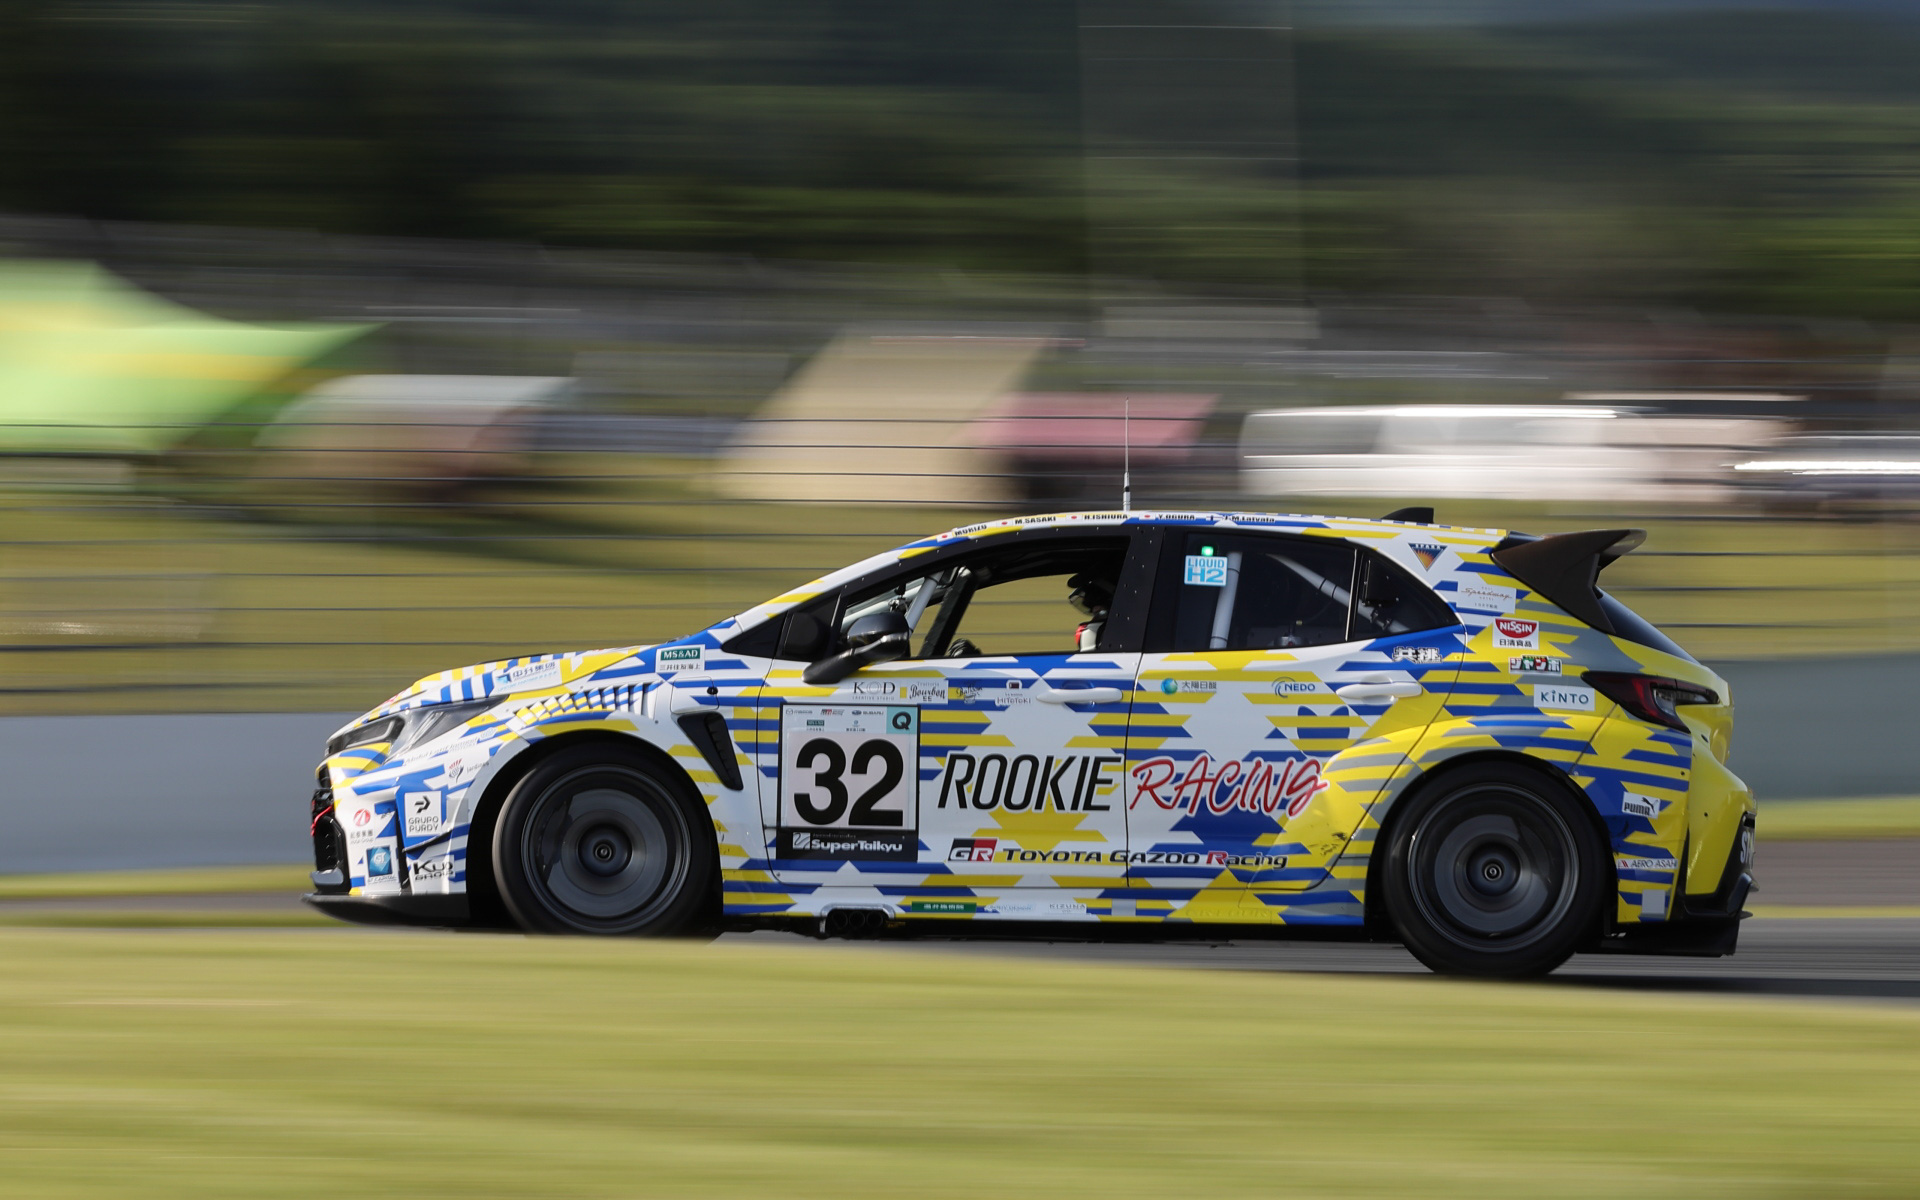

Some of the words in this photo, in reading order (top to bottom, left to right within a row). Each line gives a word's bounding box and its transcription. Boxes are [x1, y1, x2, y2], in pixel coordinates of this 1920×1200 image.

[1015, 516, 1056, 524] M.SASAKI
[1188, 558, 1225, 568] LIQUID
[1187, 568, 1224, 583] H2
[1500, 619, 1533, 634] NISSIN
[1499, 638, 1533, 648] 日清食品
[663, 649, 698, 659] MS&AD
[1510, 657, 1560, 672] ジャンボ
[909, 683, 945, 699] Bourbon
[1284, 682, 1316, 692] NEDO
[892, 711, 912, 730] Q
[793, 737, 904, 827] 32
[938, 754, 1124, 812] ROOKIE
[1129, 756, 1327, 816] RACING
[1623, 801, 1650, 817] PUMA
[408, 815, 439, 824] GRUPO
[409, 824, 439, 833] PURDY
[950, 845, 994, 862] GR
[1002, 847, 1101, 862] TOYOTA
[1109, 849, 1200, 864] GAZOO
[1205, 851, 1287, 869] Racing
[1630, 859, 1654, 868] AERO
